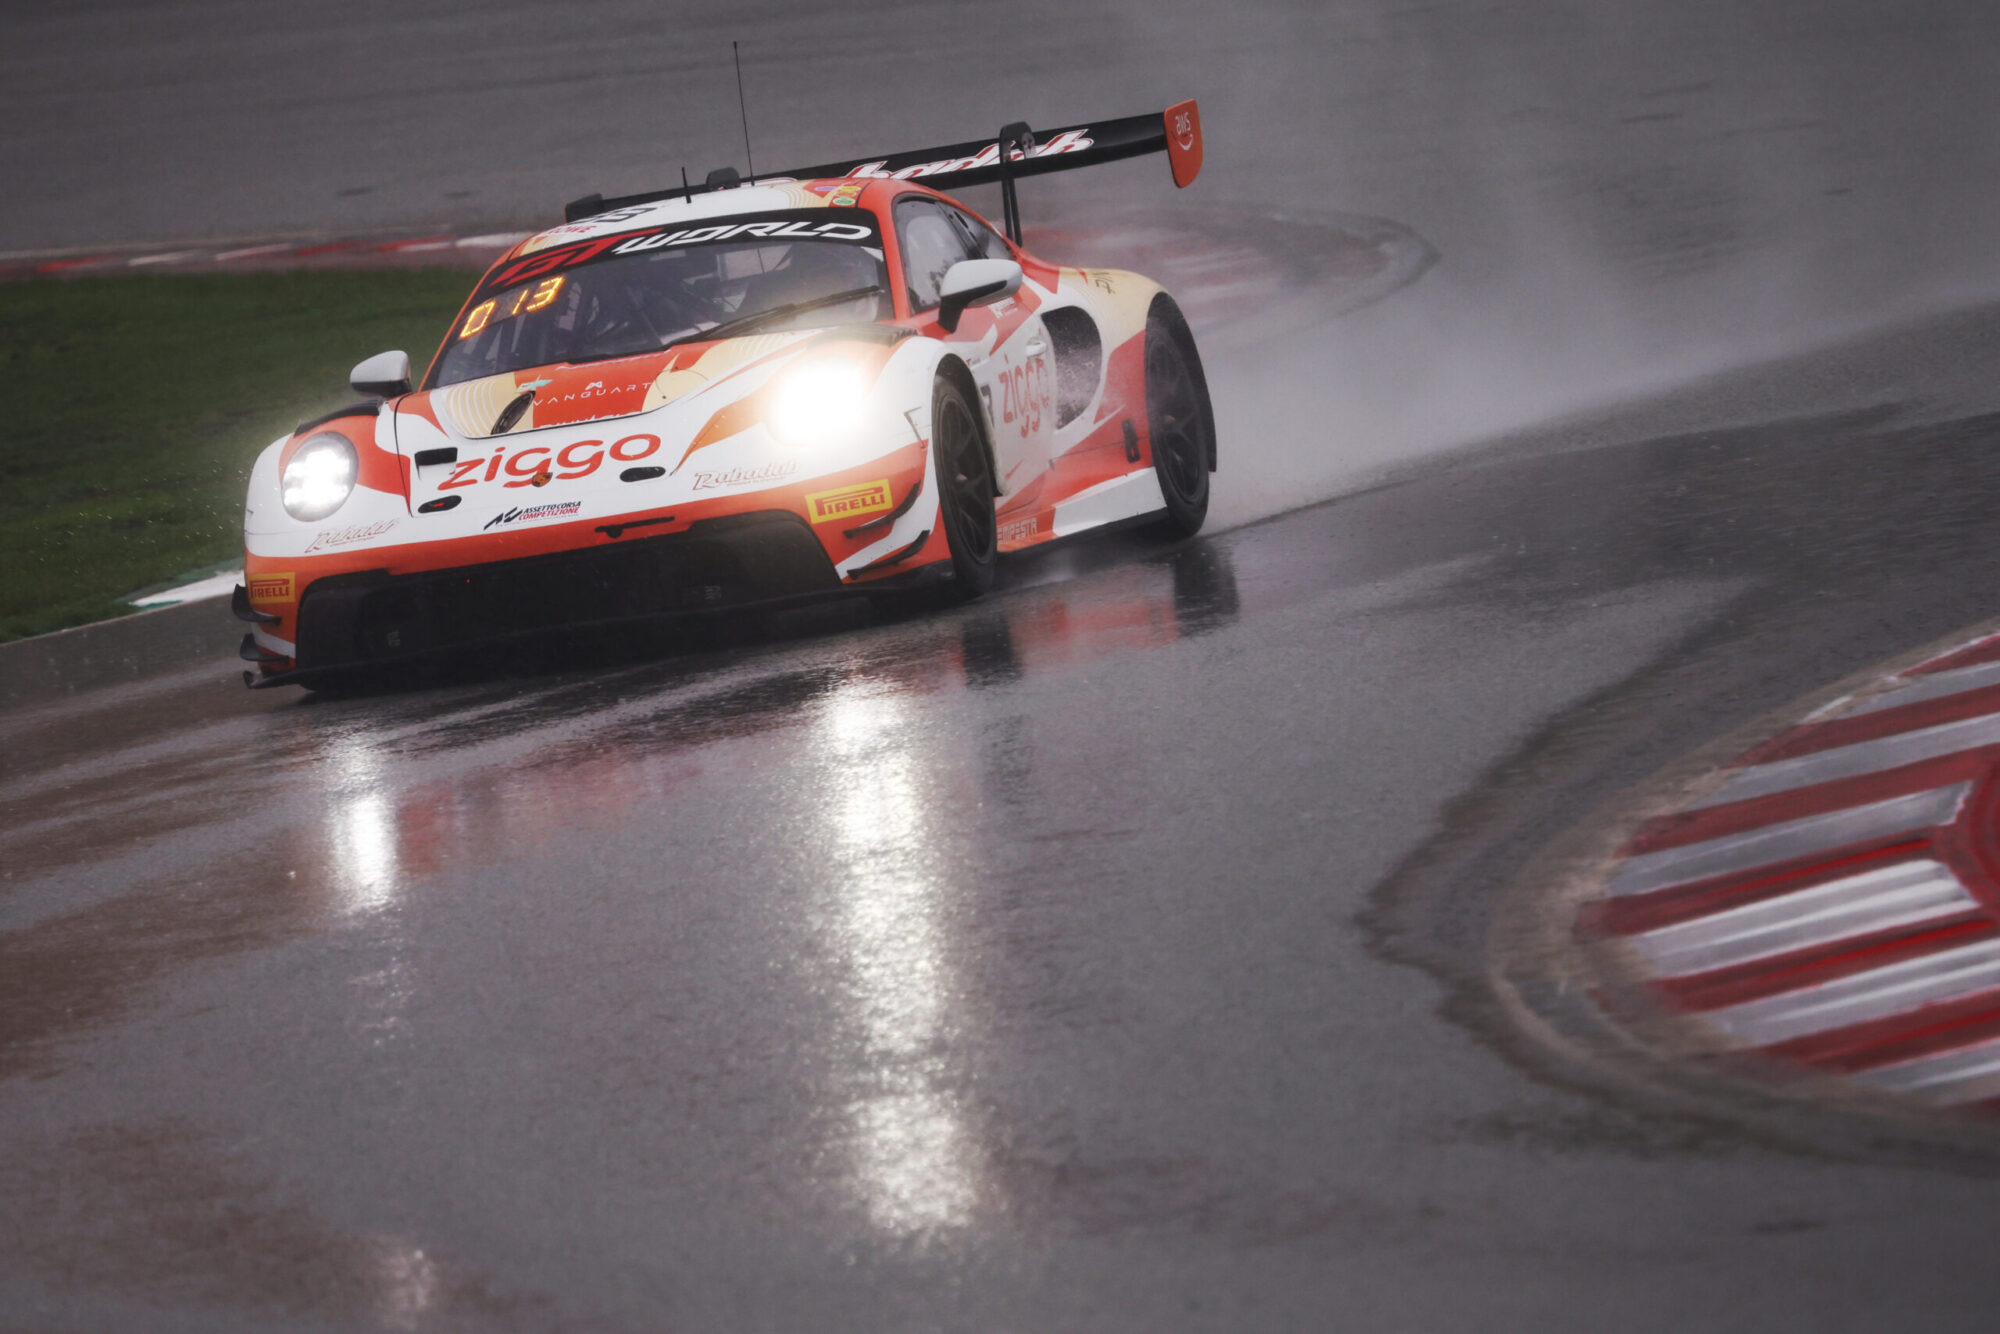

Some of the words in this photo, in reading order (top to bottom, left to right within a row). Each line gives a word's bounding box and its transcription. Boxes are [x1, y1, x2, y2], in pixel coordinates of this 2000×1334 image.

[489, 227, 664, 287] GT
[611, 221, 873, 255] WORLD
[533, 382, 652, 406] VANGUART
[437, 434, 661, 490] ziggo
[518, 506, 580, 521] COMPETIZIONE
[524, 503, 557, 514] ASSETTO
[556, 500, 582, 510] CORSA
[814, 485, 887, 517] PIRELLI
[996, 517, 1038, 545] EMPESTA
[249, 578, 290, 599] PIRELLI
